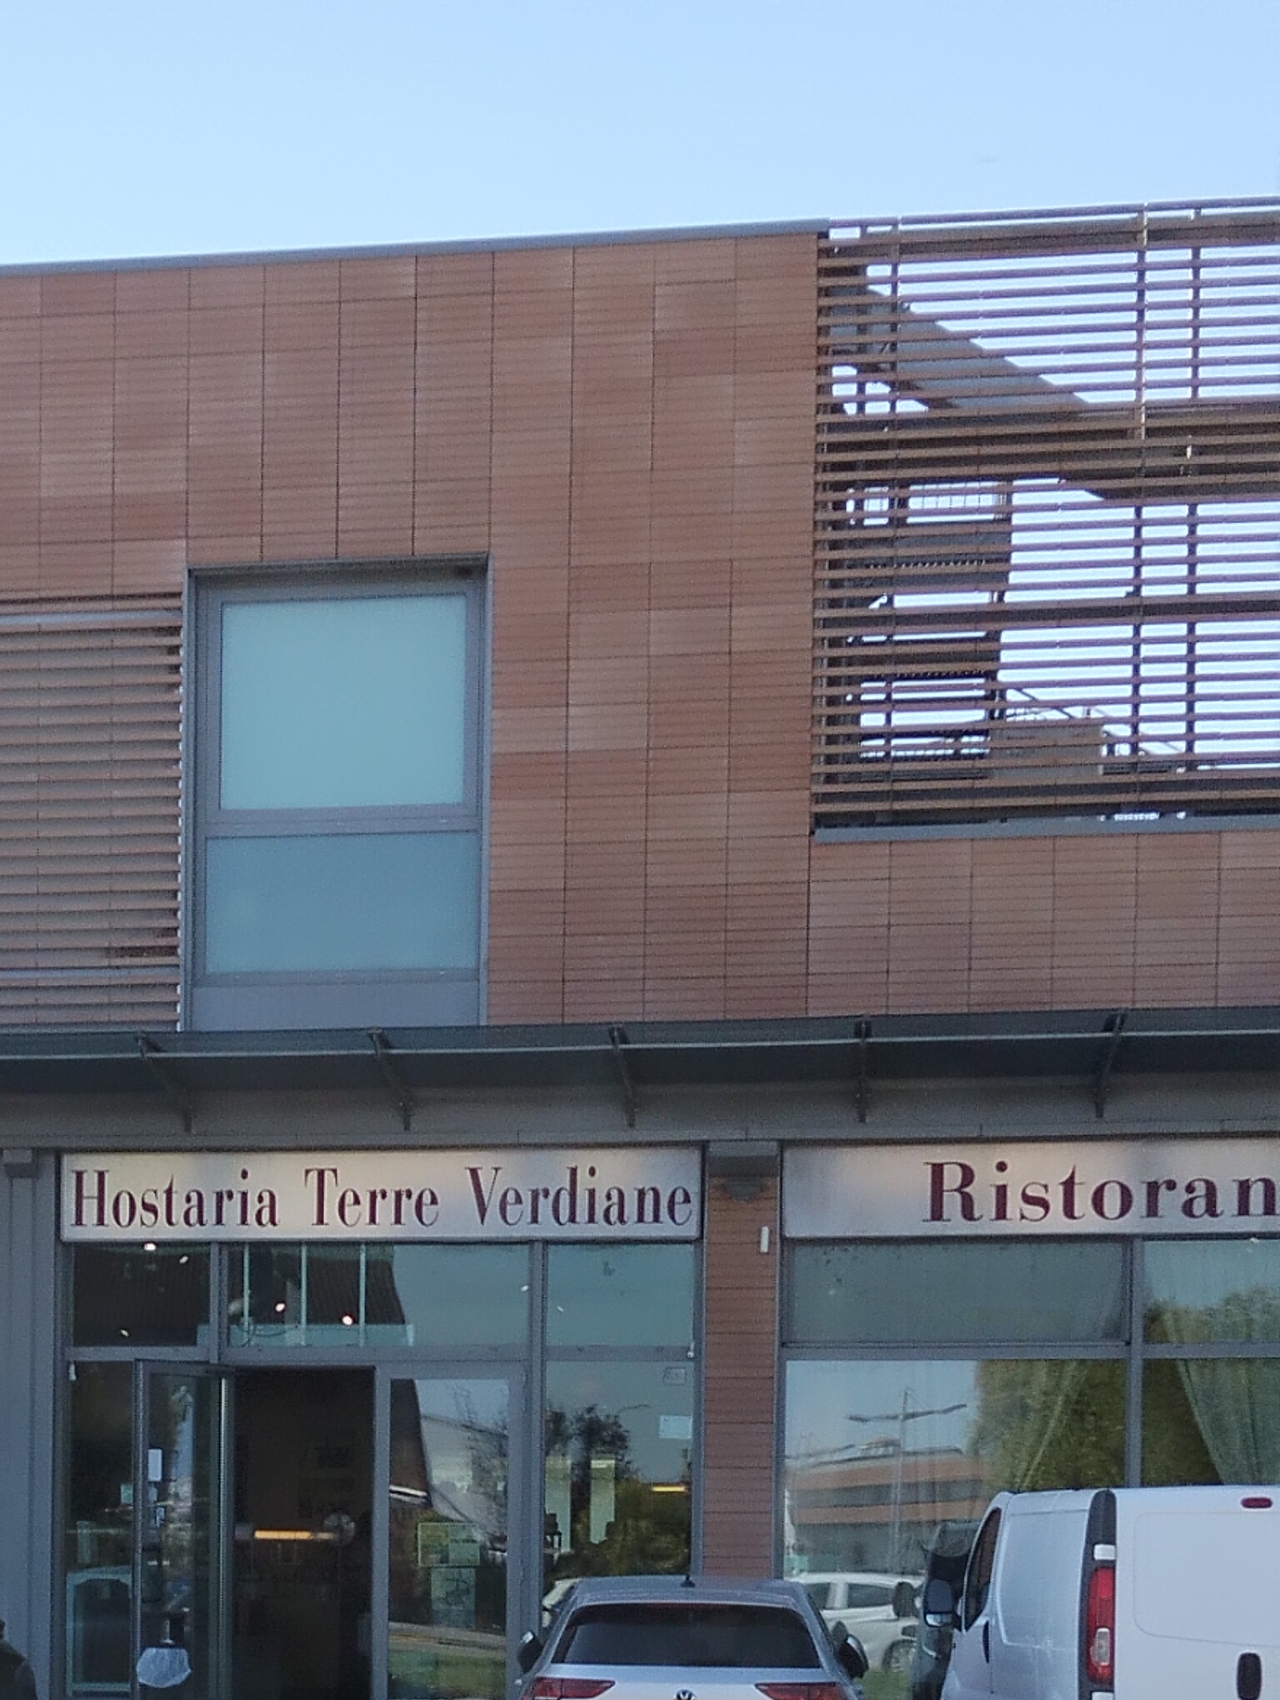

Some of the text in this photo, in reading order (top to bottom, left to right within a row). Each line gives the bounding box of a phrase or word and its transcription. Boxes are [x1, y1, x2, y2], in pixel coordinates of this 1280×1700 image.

[71, 1164, 693, 1229] Hostaria Terre Verdiane
